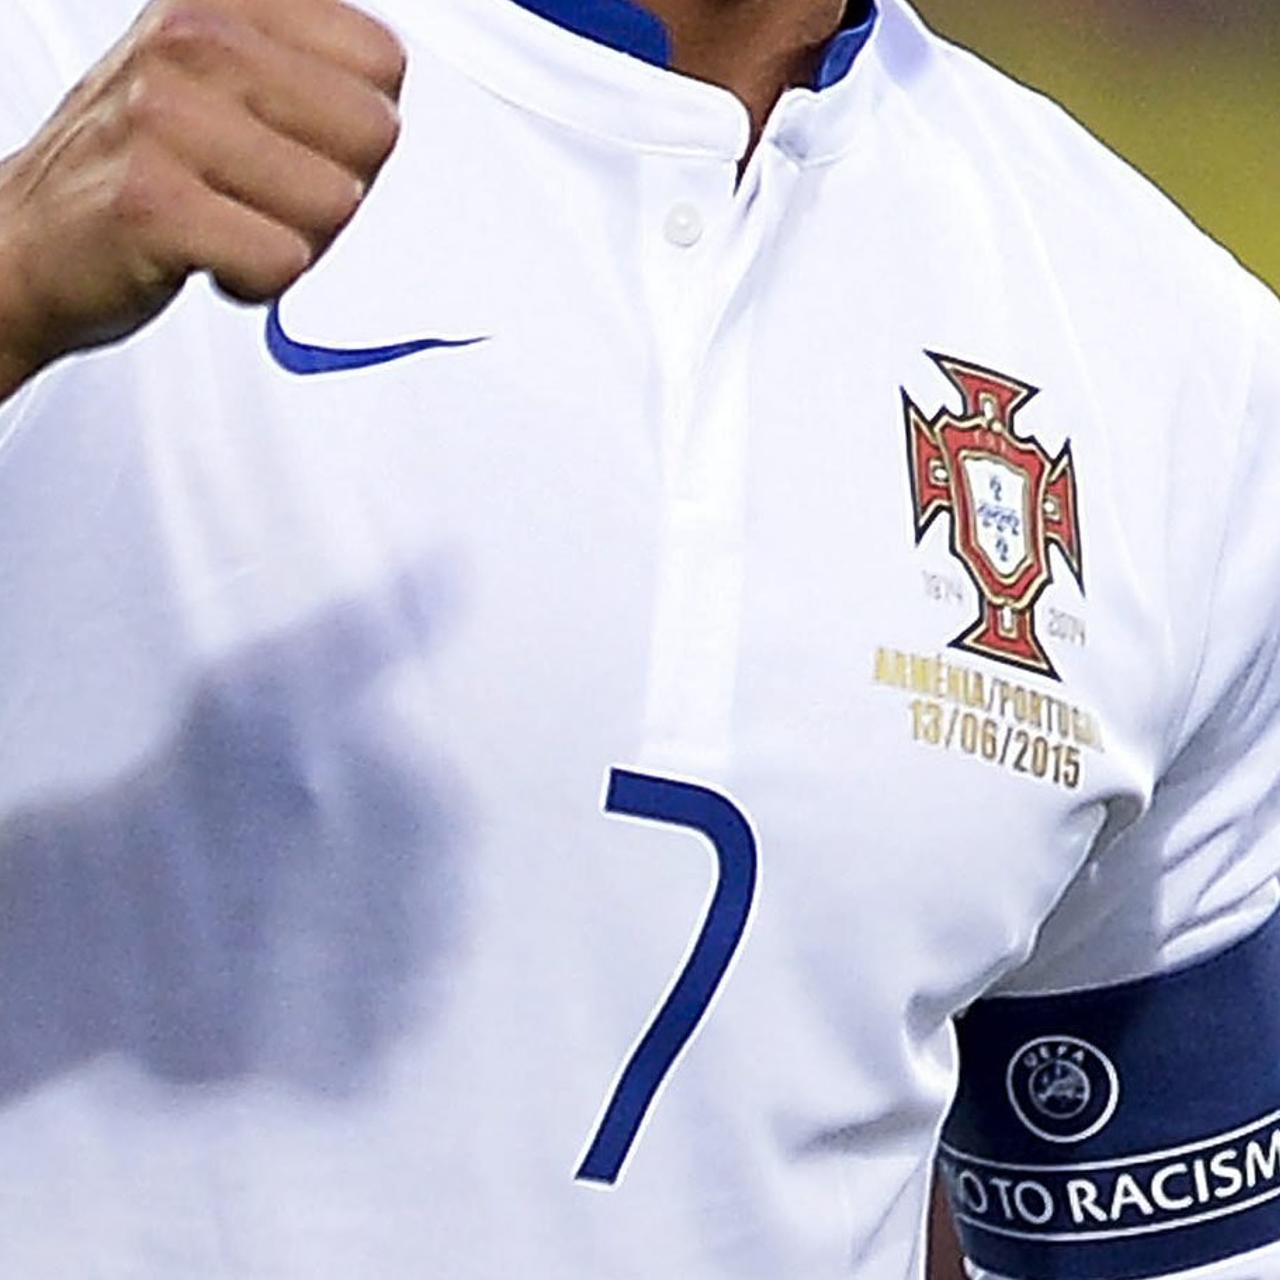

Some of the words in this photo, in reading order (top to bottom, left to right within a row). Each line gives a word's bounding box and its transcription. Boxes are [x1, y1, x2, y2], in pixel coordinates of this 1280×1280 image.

[875, 647, 1104, 753] ARMÉNIA/PORTUG
[909, 699, 1081, 789] 13/06/2015
[575, 767, 758, 1185] 7
[989, 1177, 1054, 1225] TO
